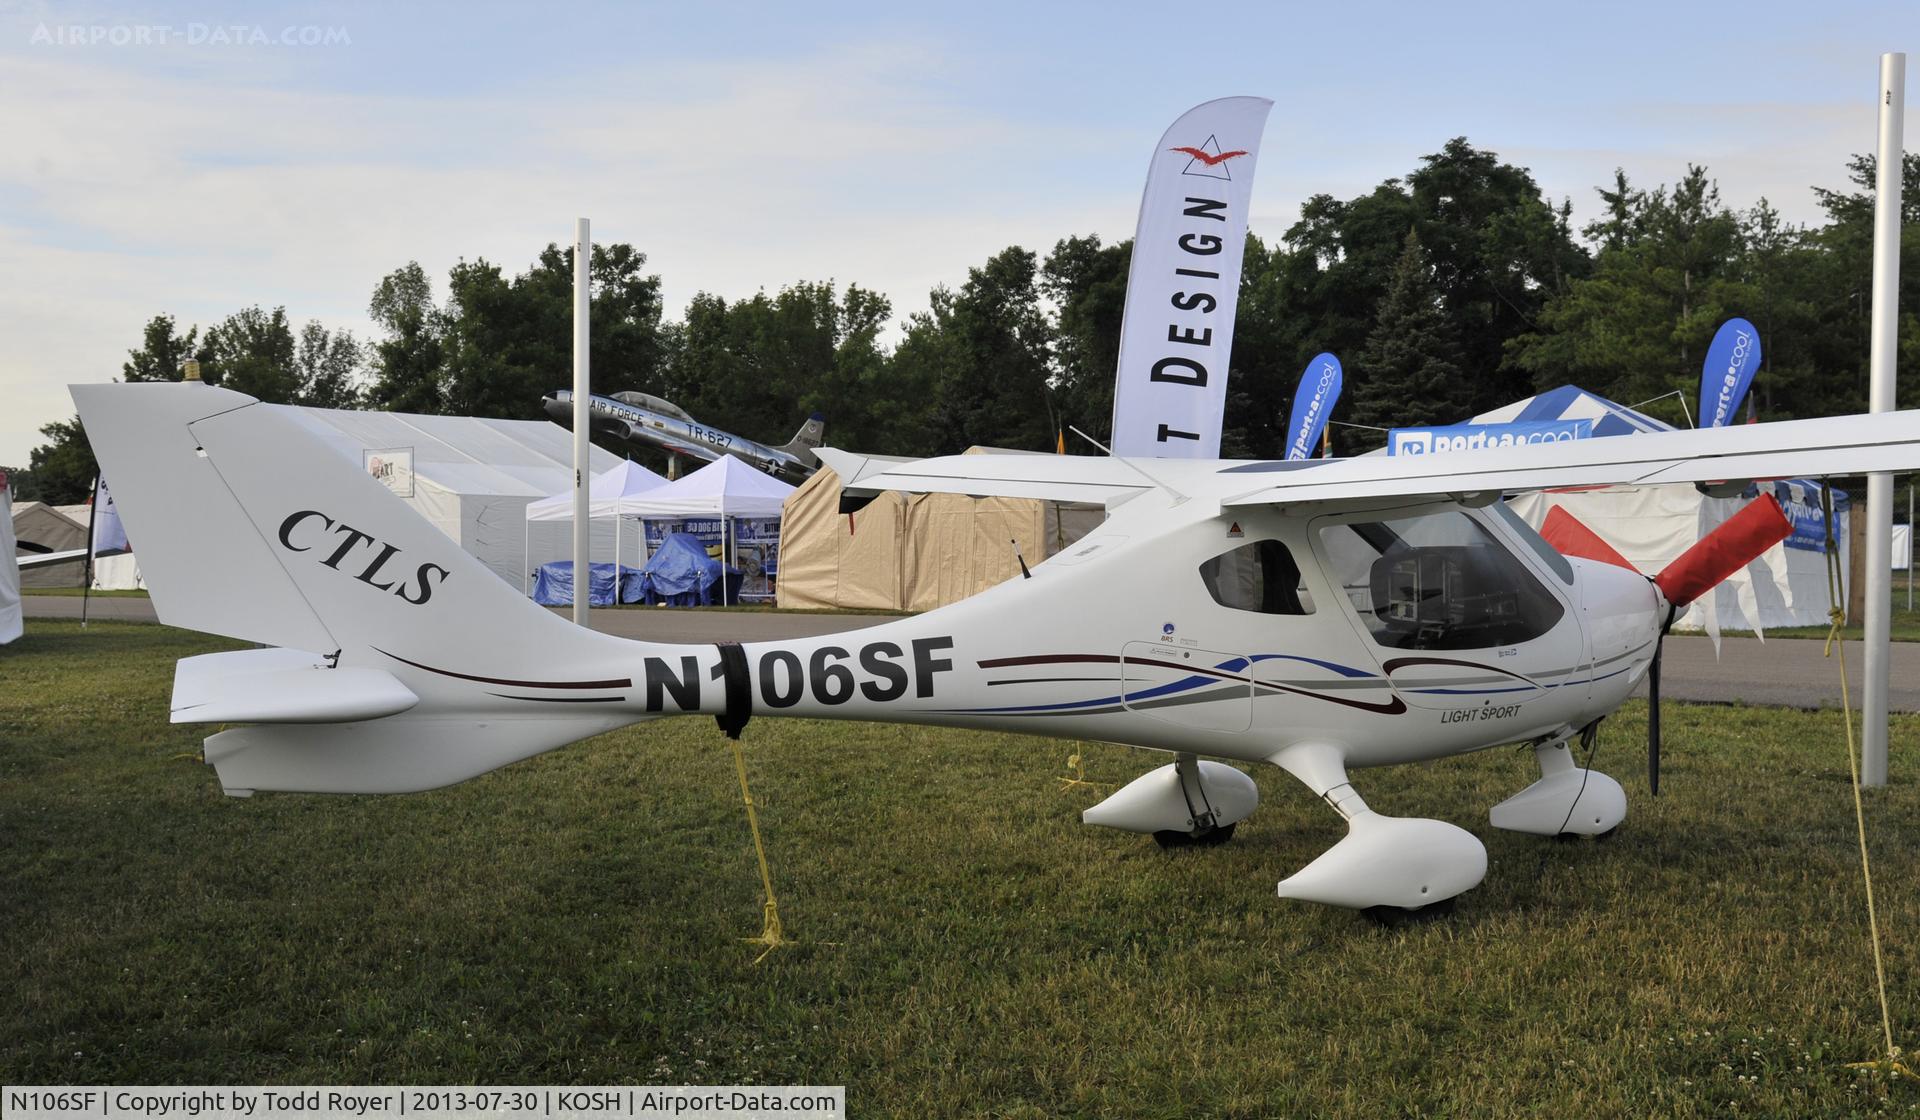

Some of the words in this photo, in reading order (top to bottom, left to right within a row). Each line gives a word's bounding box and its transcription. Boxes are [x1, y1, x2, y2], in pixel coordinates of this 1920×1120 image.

[1150, 197, 1228, 387] DESIGN
[590, 399, 607, 413] AIR
[611, 405, 644, 422] FORCE
[686, 423, 732, 448] TR-627
[279, 511, 450, 604] CTLS
[644, 636, 954, 712] N06SF
[1441, 709, 1479, 723] LIGHT
[1480, 705, 1522, 720] SPORT
